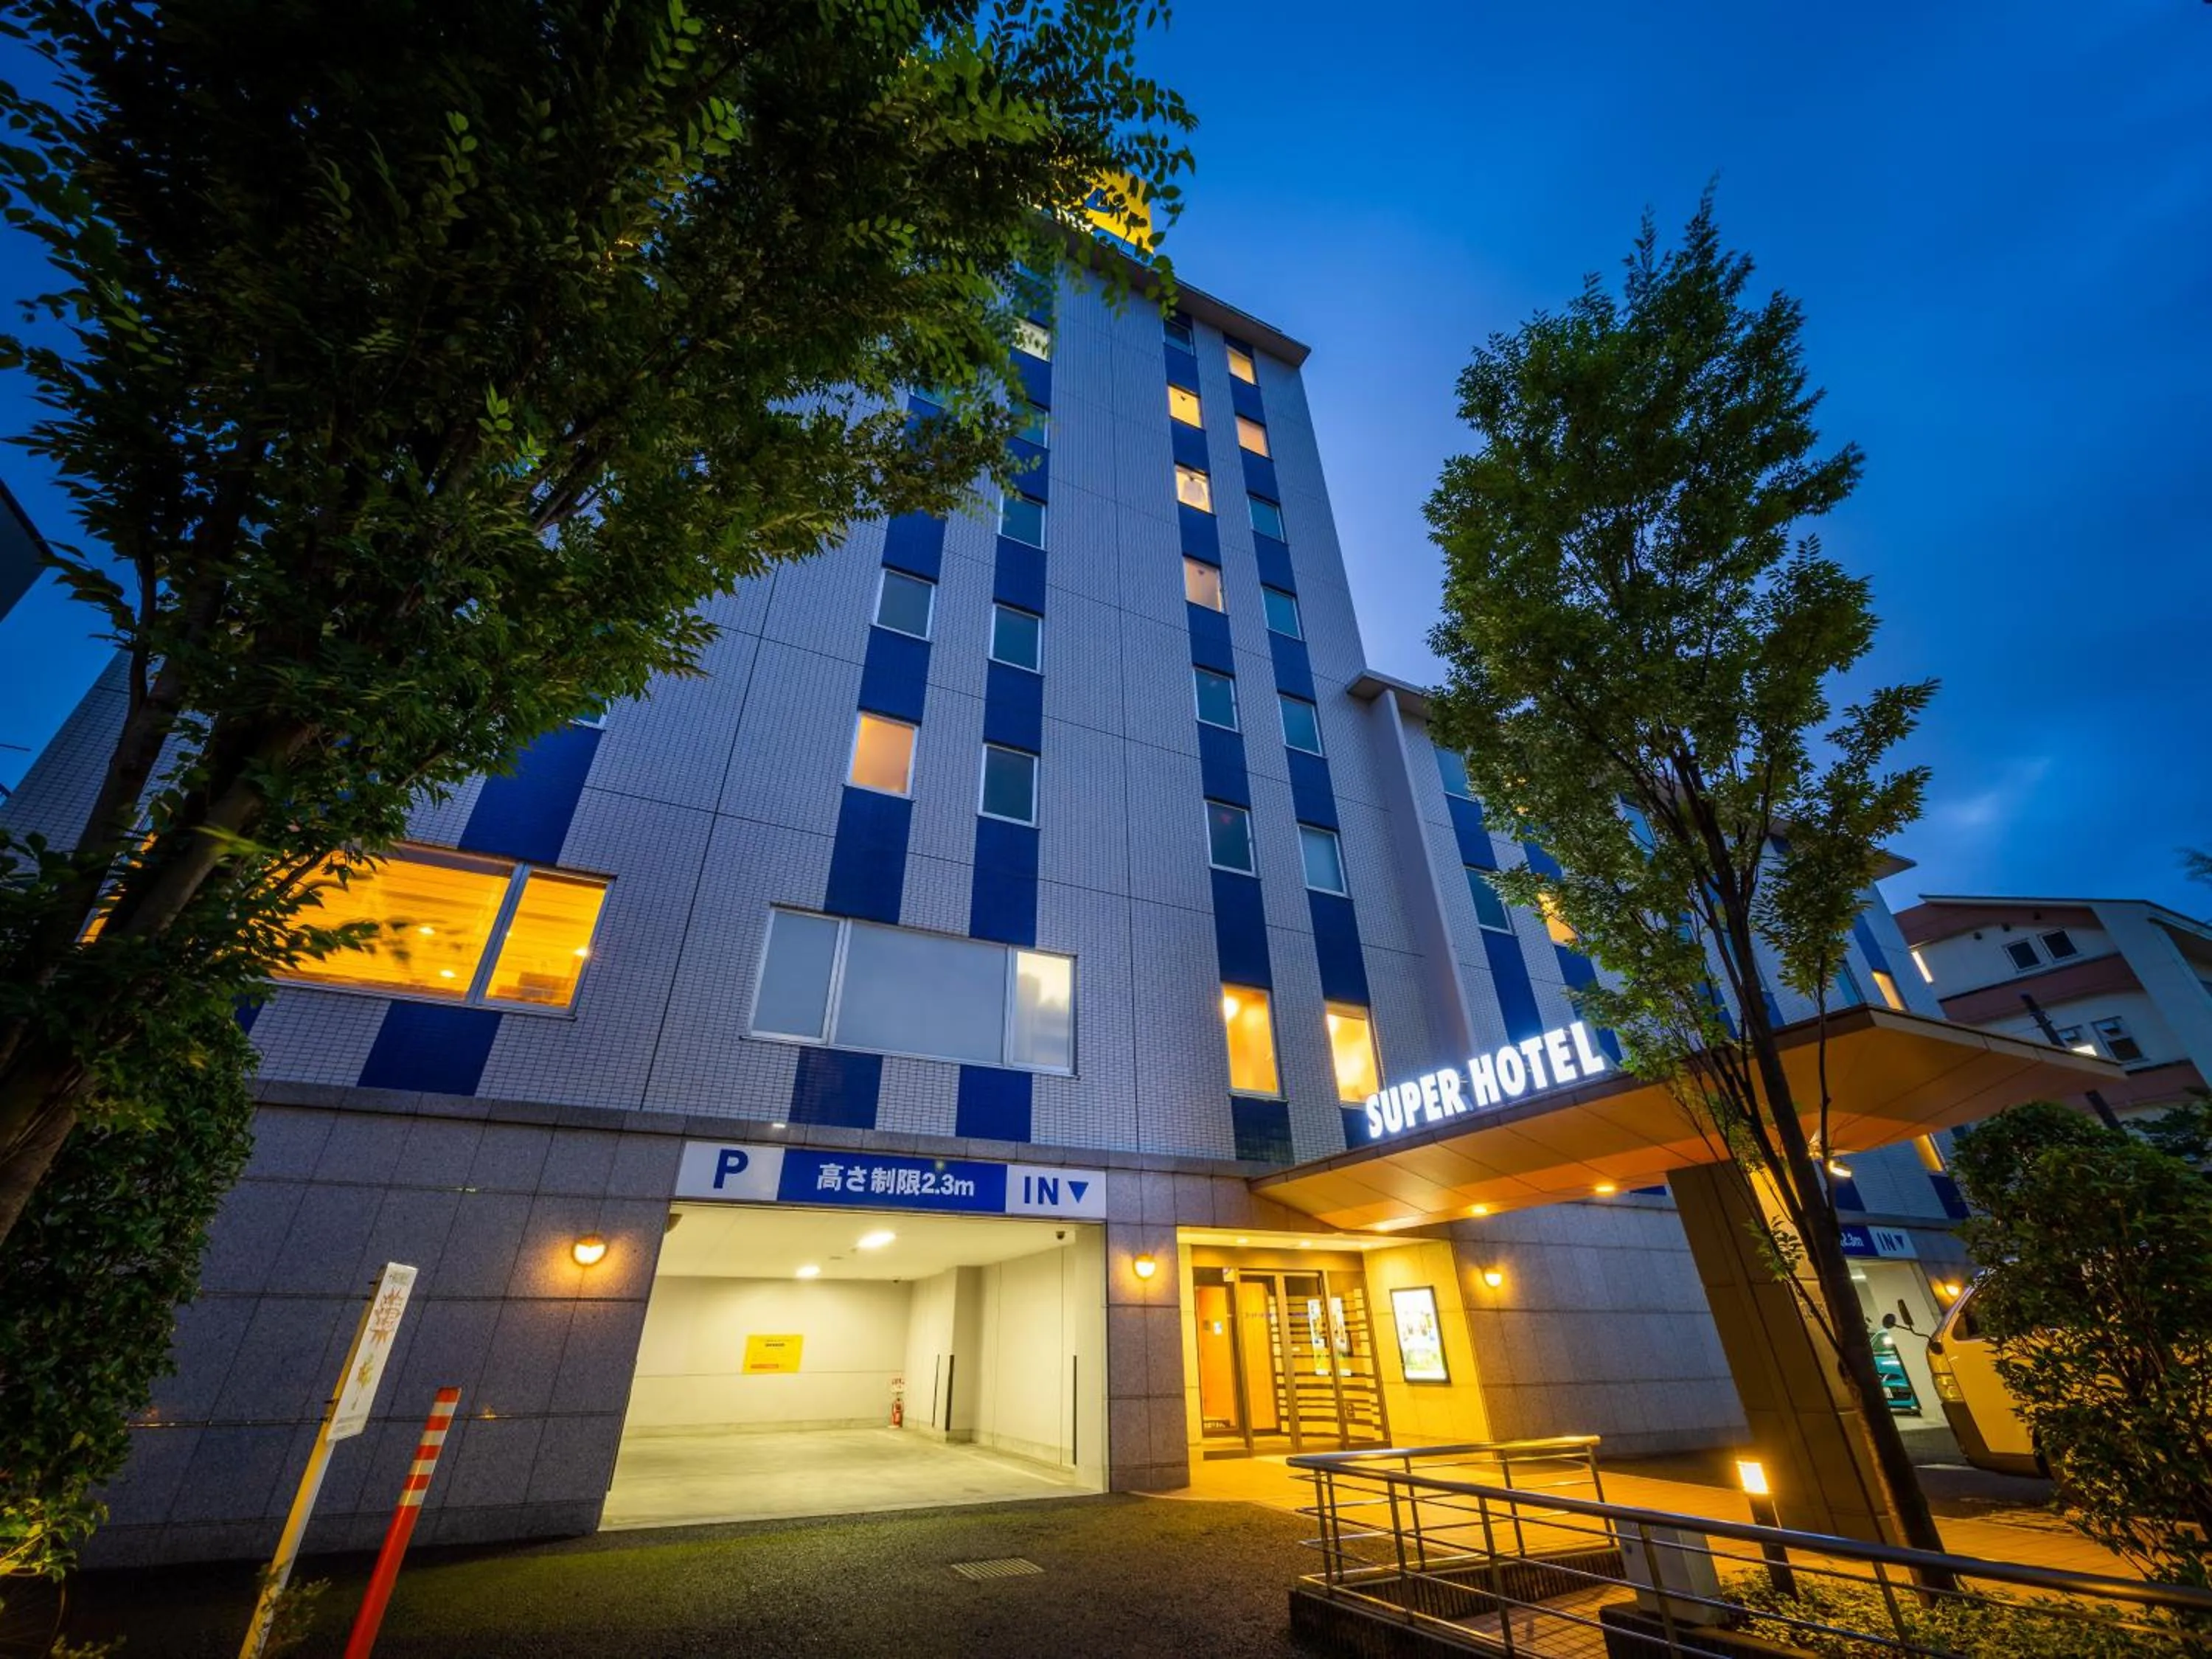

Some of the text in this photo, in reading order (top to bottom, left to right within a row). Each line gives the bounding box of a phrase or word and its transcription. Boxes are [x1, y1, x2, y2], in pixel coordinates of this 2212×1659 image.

[1366, 1022, 1604, 1138] SUPER HOTEL
[713, 1149, 1059, 1206] P 高さ制限2.3m IN
[1877, 1232, 1897, 1251] IN
